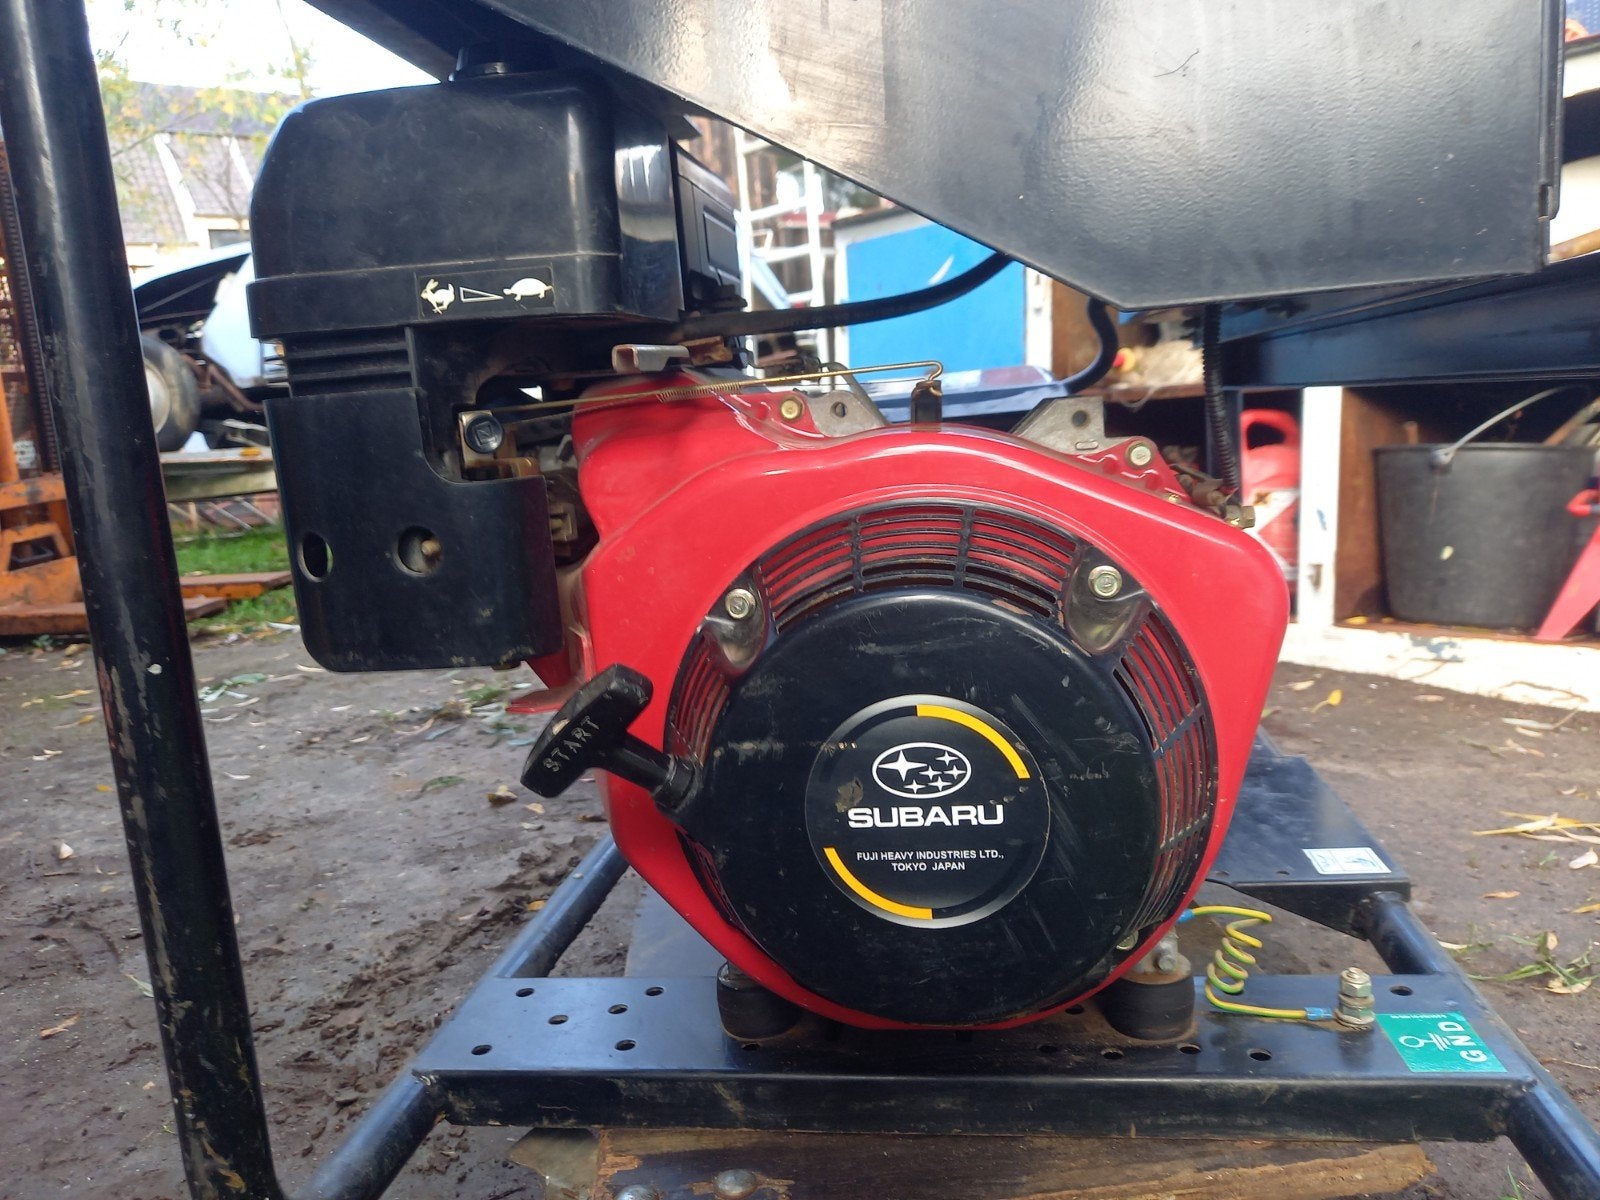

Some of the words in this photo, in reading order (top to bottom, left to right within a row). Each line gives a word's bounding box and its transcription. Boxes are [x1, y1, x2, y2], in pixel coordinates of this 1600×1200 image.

[542, 715, 601, 773] START
[847, 804, 1005, 829] SUBARU
[856, 851, 879, 861] FUJI
[880, 850, 914, 861] HEAVY
[916, 849, 977, 860] INDUSTRIES
[979, 848, 1005, 860] LTD.,
[891, 861, 927, 872] TOKYO
[932, 861, 966, 871] JAPAN
[1437, 1021, 1489, 1063] GND
